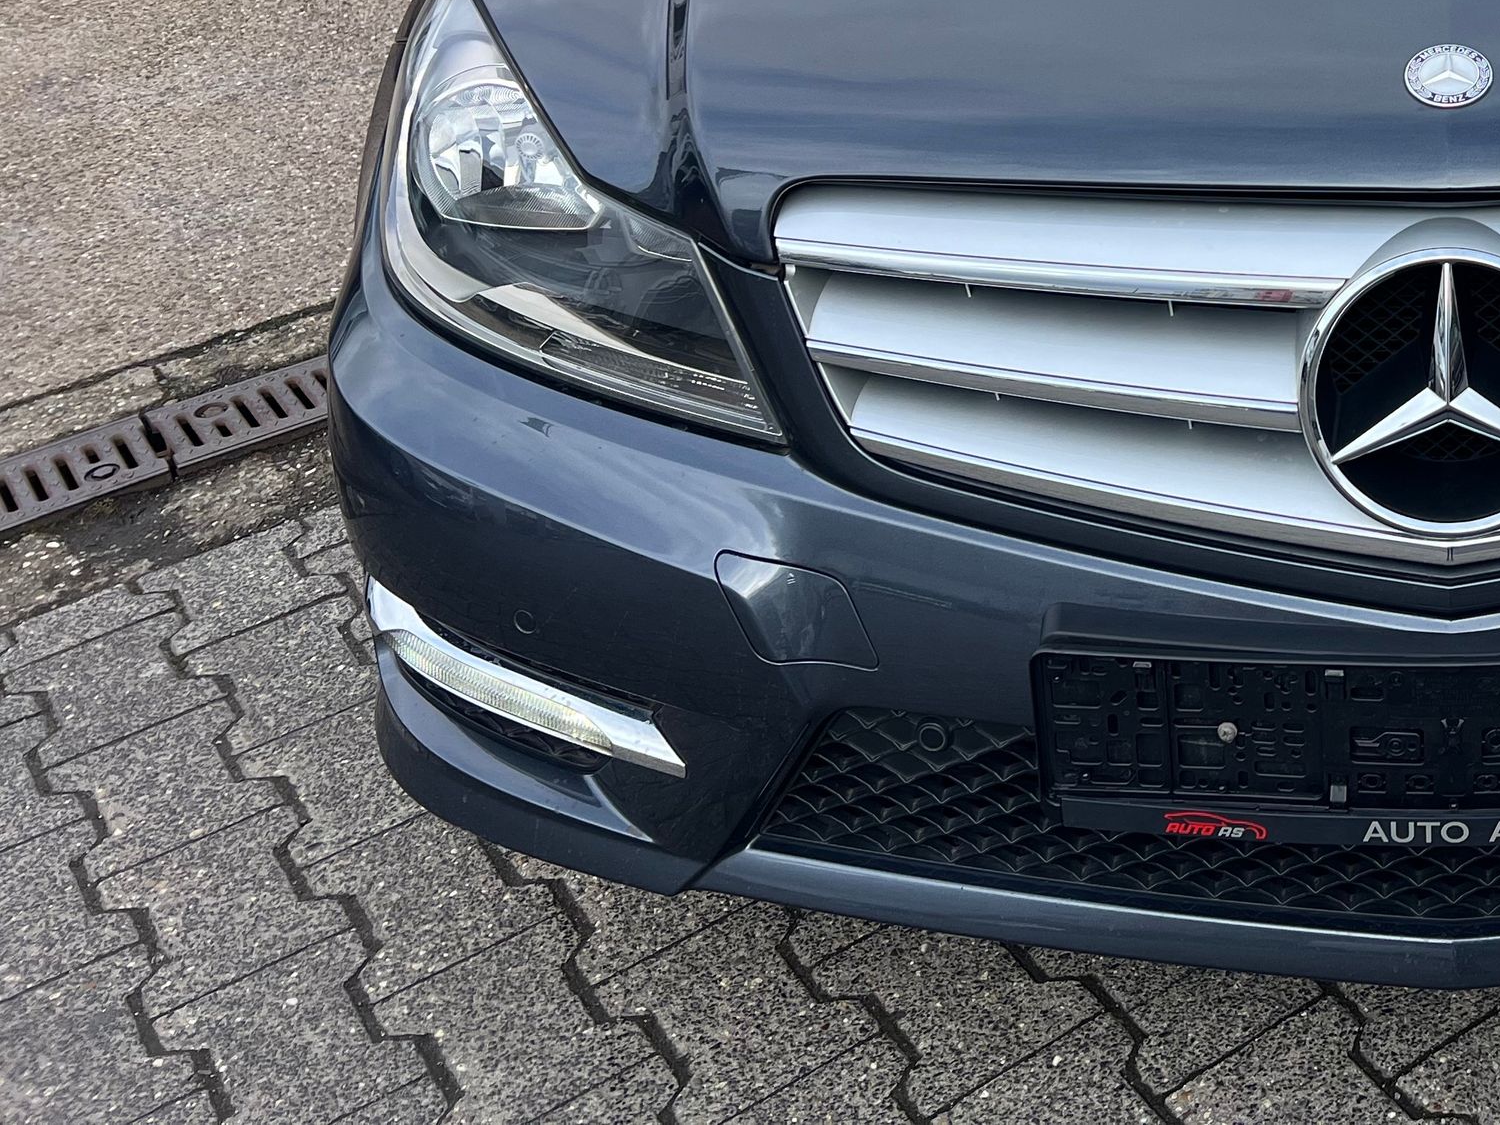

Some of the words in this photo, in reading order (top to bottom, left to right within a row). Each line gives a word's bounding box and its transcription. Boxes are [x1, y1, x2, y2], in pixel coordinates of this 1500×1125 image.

[1418, 45, 1479, 60] MERCEDES
[1433, 94, 1466, 104] BENZ
[1165, 822, 1217, 836] AUTO
[1217, 826, 1246, 838] AS
[1362, 820, 1470, 844] AUTO
